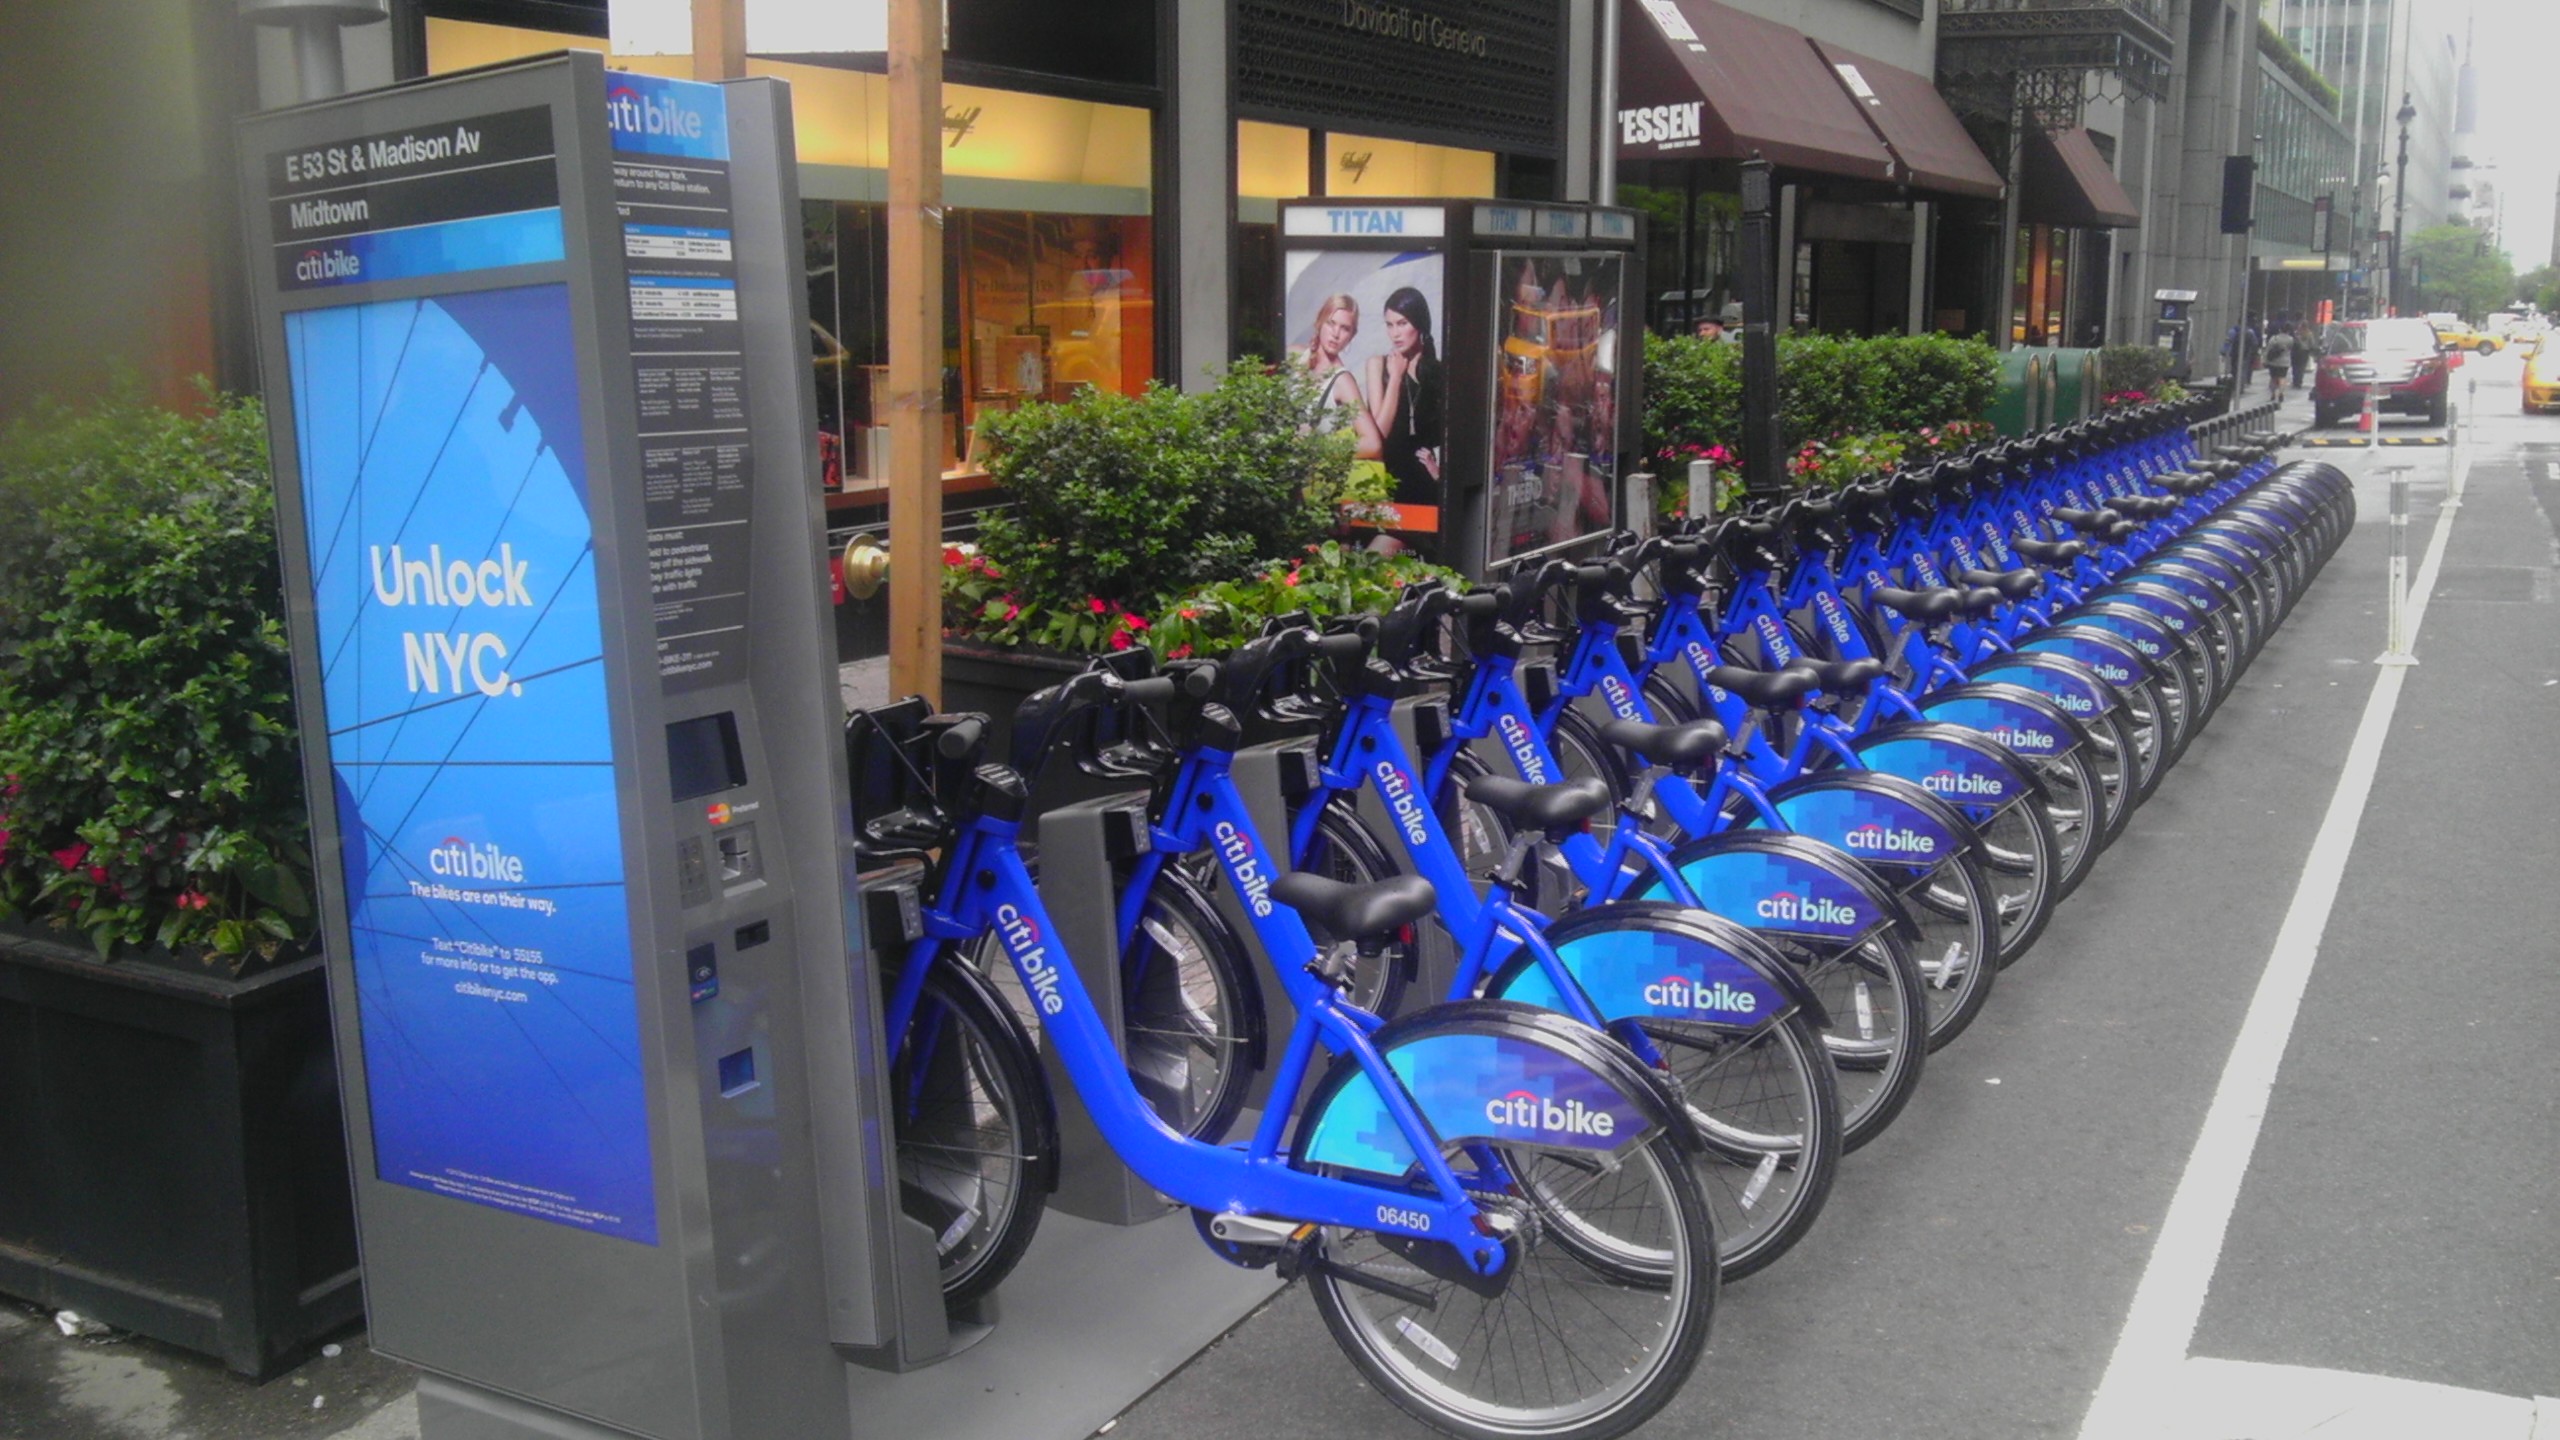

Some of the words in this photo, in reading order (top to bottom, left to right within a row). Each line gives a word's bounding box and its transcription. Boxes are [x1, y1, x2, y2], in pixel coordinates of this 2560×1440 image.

[1344, 0, 1410, 39] Davidoff
[1412, 13, 1427, 44] of
[1430, 17, 1486, 57] Geneva
[643, 95, 702, 139] bike
[286, 155, 300, 183] E
[302, 152, 325, 181] 53
[327, 149, 349, 176] St
[351, 145, 367, 172] &
[368, 134, 451, 170] Madison
[455, 126, 481, 156] Av
[290, 199, 369, 230] Midtown
[1327, 210, 1404, 234] TITAN
[1489, 208, 1518, 232] TITAN
[324, 249, 360, 279] bike
[370, 543, 533, 607] Unlock
[1827, 611, 1850, 643] bike
[403, 632, 522, 697] NYC.
[1768, 636, 1791, 668] bik
[1500, 714, 1531, 746] citi
[2013, 728, 2055, 749] bike
[1515, 742, 1547, 787] bike
[1922, 770, 1955, 793] citi
[1958, 773, 2003, 795] bike
[1376, 761, 1410, 798] citi
[1393, 794, 1427, 846] bike
[430, 837, 468, 876] citi
[469, 842, 523, 882] bike
[1215, 821, 1254, 864] citi
[1235, 859, 1273, 918] bike
[409, 880, 431, 897] The
[432, 883, 461, 901] bikes
[462, 890, 481, 903] are
[482, 893, 497, 905] on
[498, 892, 525, 908] their
[527, 898, 557, 917] way.
[1757, 893, 1797, 921] citi
[1801, 898, 1856, 926] bike
[432, 937, 454, 951] Text
[500, 948, 511, 960] to
[997, 903, 1040, 953] citi
[1020, 946, 1063, 1016] bike
[421, 952, 435, 965] for
[436, 955, 459, 970] more
[460, 957, 478, 972] info
[478, 962, 490, 974] or
[490, 962, 501, 976] to
[501, 964, 518, 980] get
[519, 966, 536, 981] the
[1644, 977, 1689, 1008] citi
[1693, 982, 1757, 1013] bike
[1486, 1091, 1538, 1129] citi
[1543, 1098, 1615, 1137] bike
[1376, 1205, 1431, 1232] 06450
